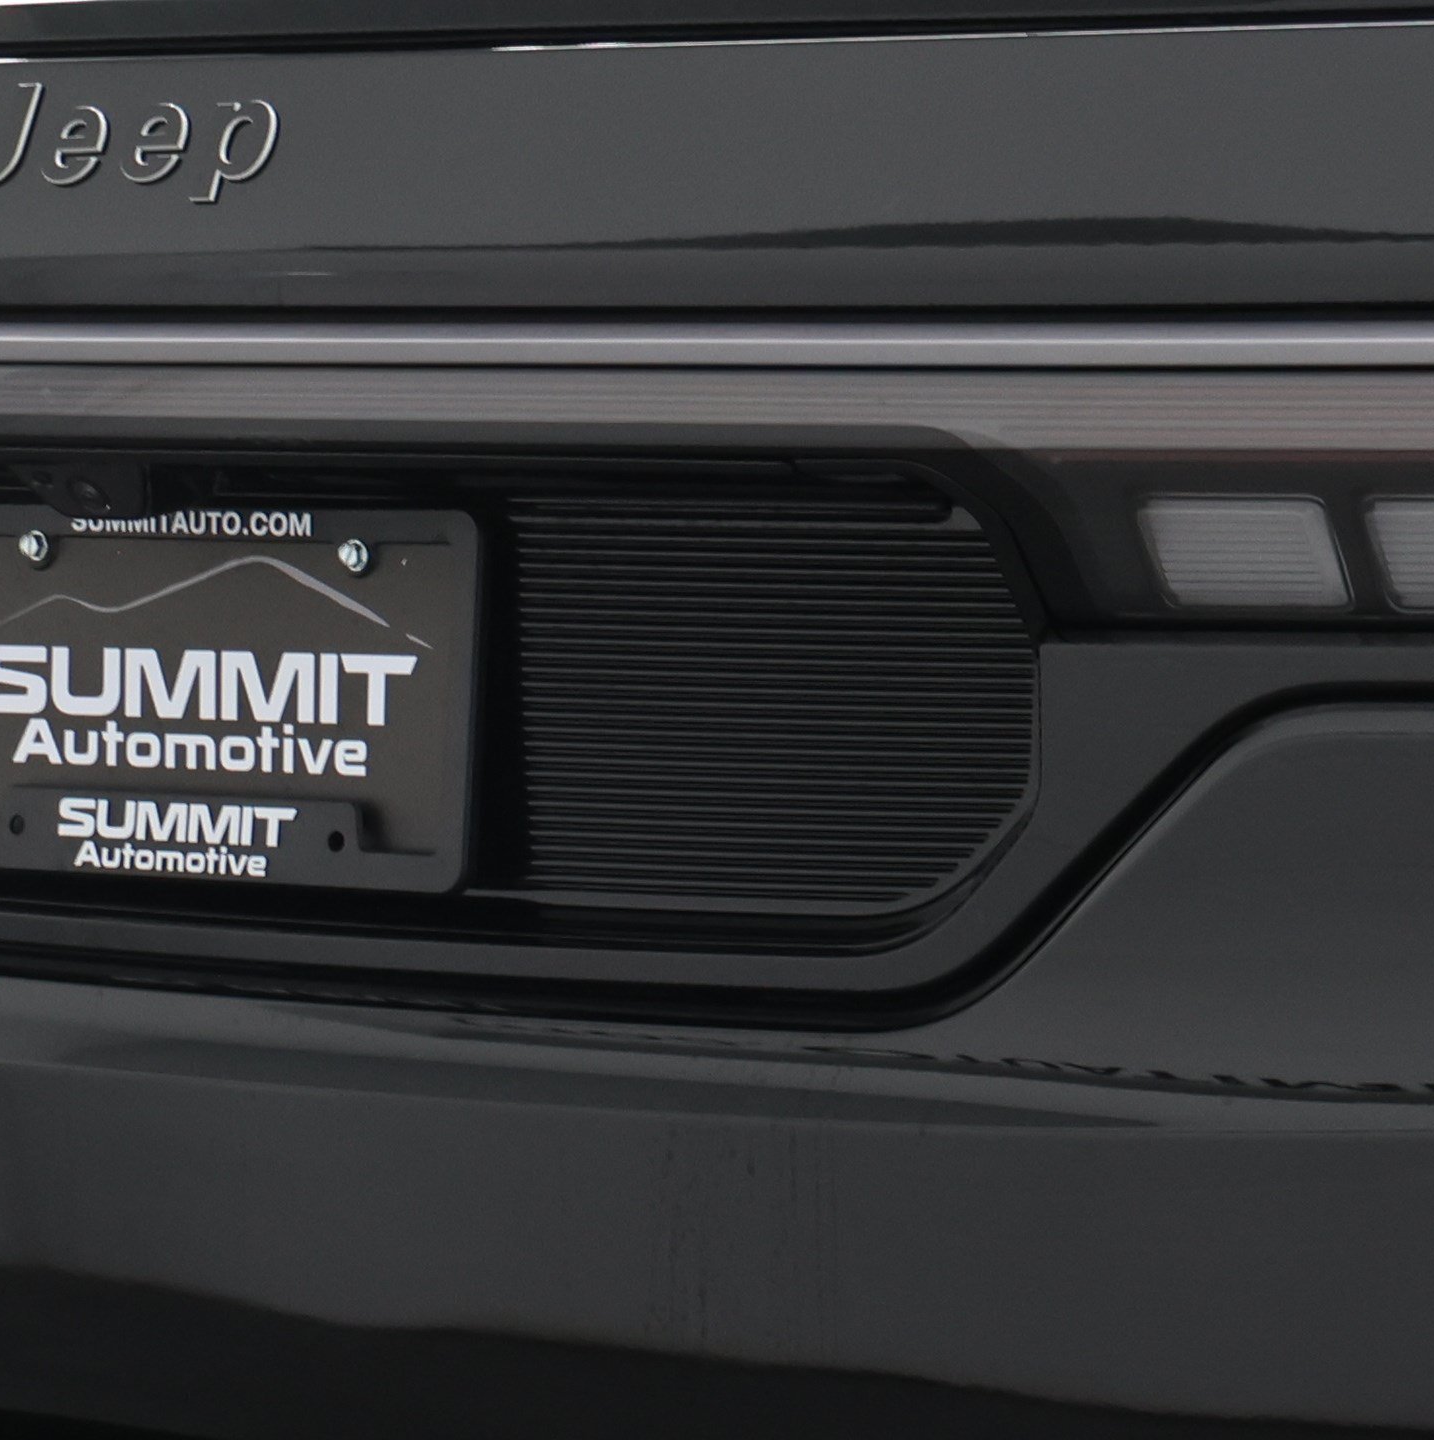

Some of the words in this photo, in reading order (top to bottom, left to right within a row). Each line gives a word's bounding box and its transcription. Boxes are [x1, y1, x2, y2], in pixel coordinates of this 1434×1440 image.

[12, 718, 369, 777] Automotive
[57, 797, 298, 848] SUMMIT
[73, 840, 268, 879] Automotive
